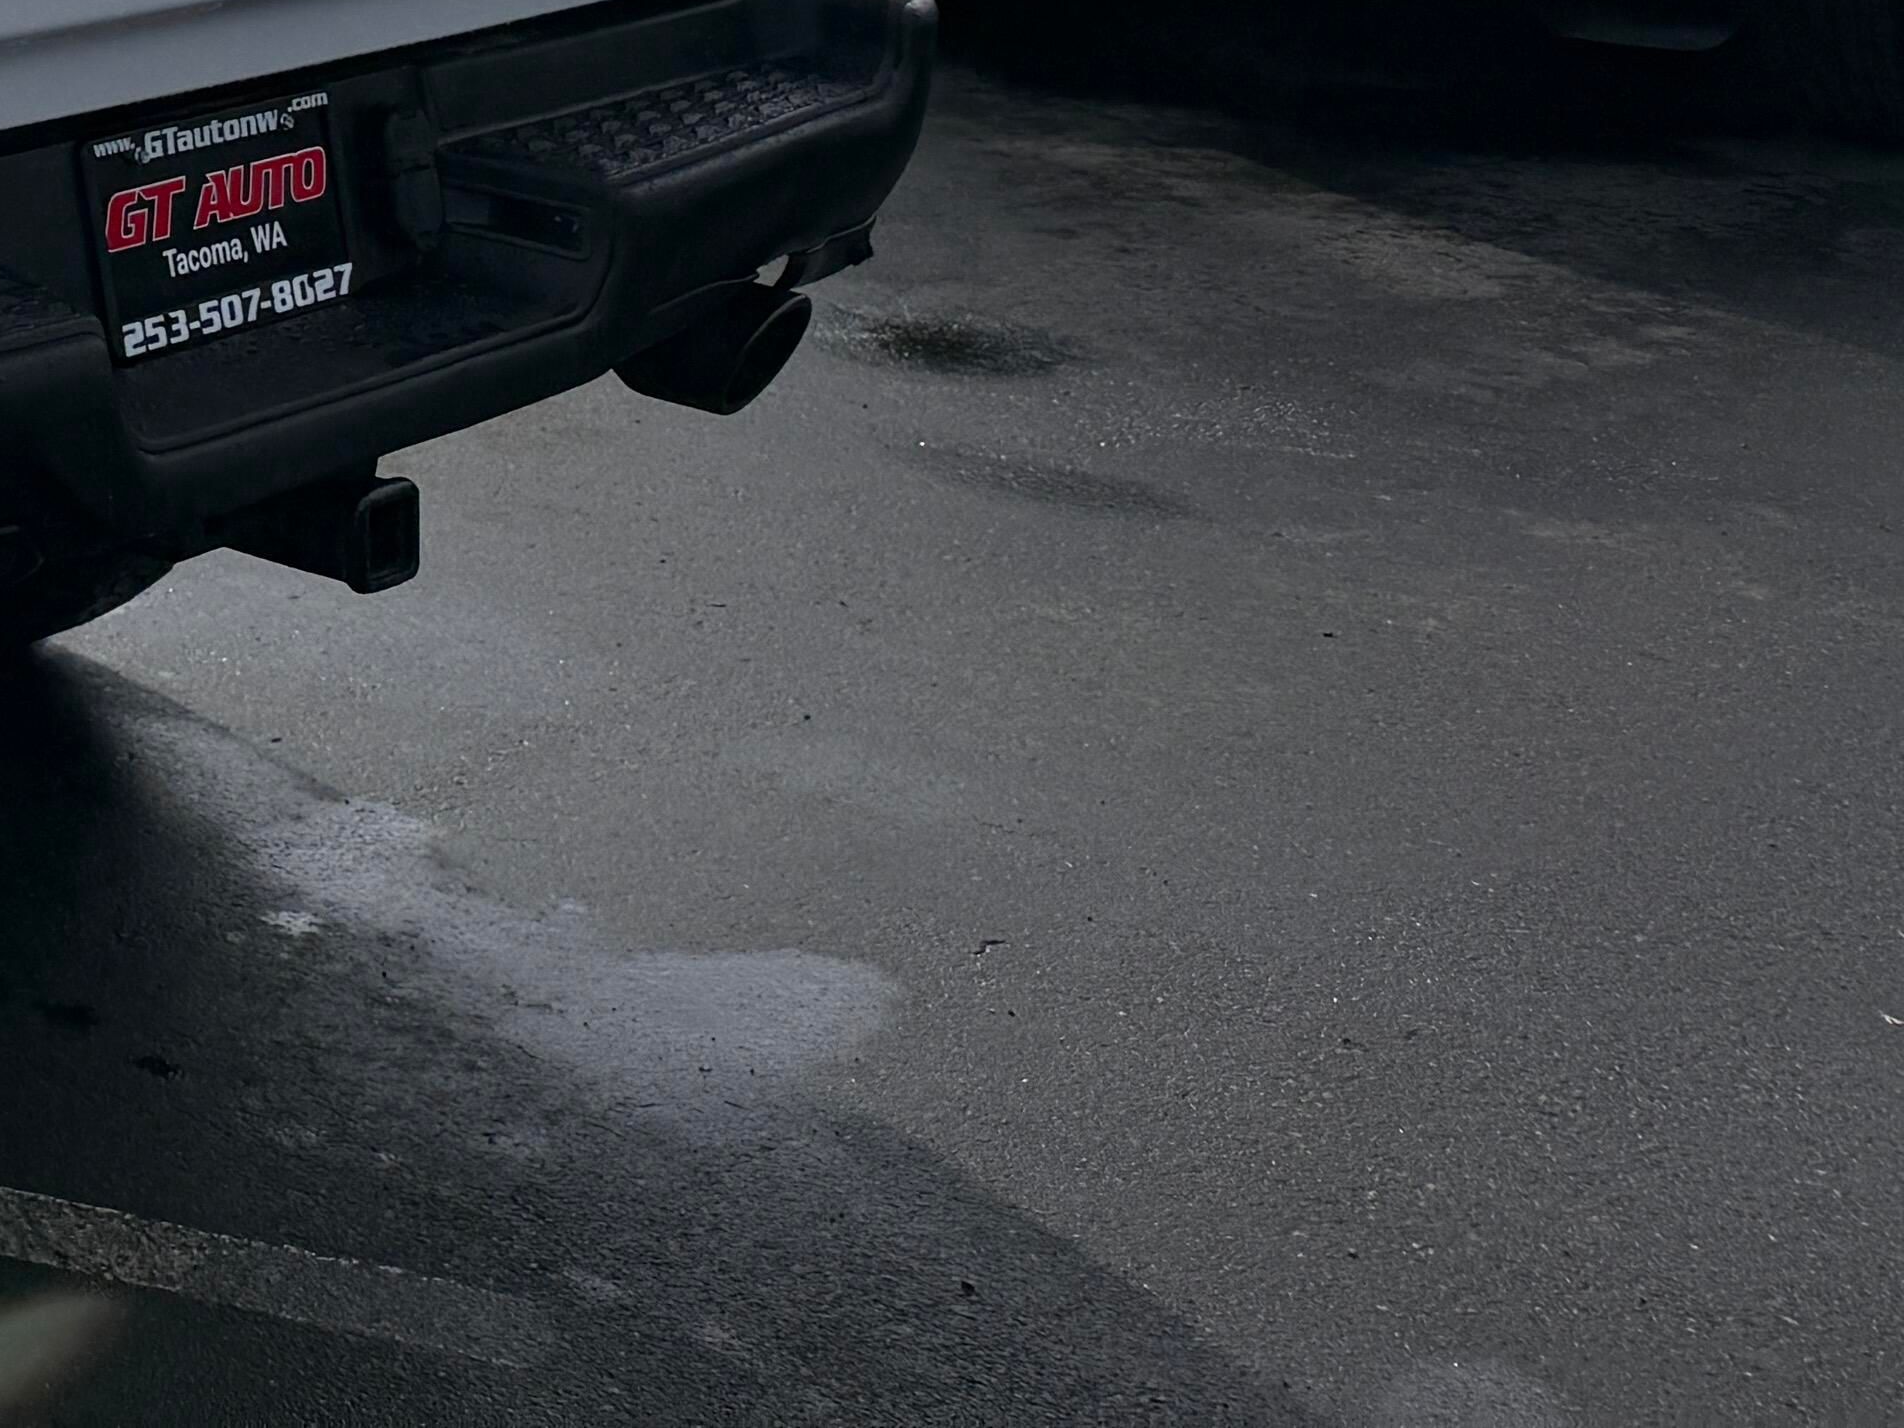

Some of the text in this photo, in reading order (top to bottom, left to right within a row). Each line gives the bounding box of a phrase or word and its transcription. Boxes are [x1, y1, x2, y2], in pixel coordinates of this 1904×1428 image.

[104, 145, 328, 254] GT AUTO
[161, 219, 289, 279] Tacoma, WA
[121, 262, 354, 359] 253-507-8027
